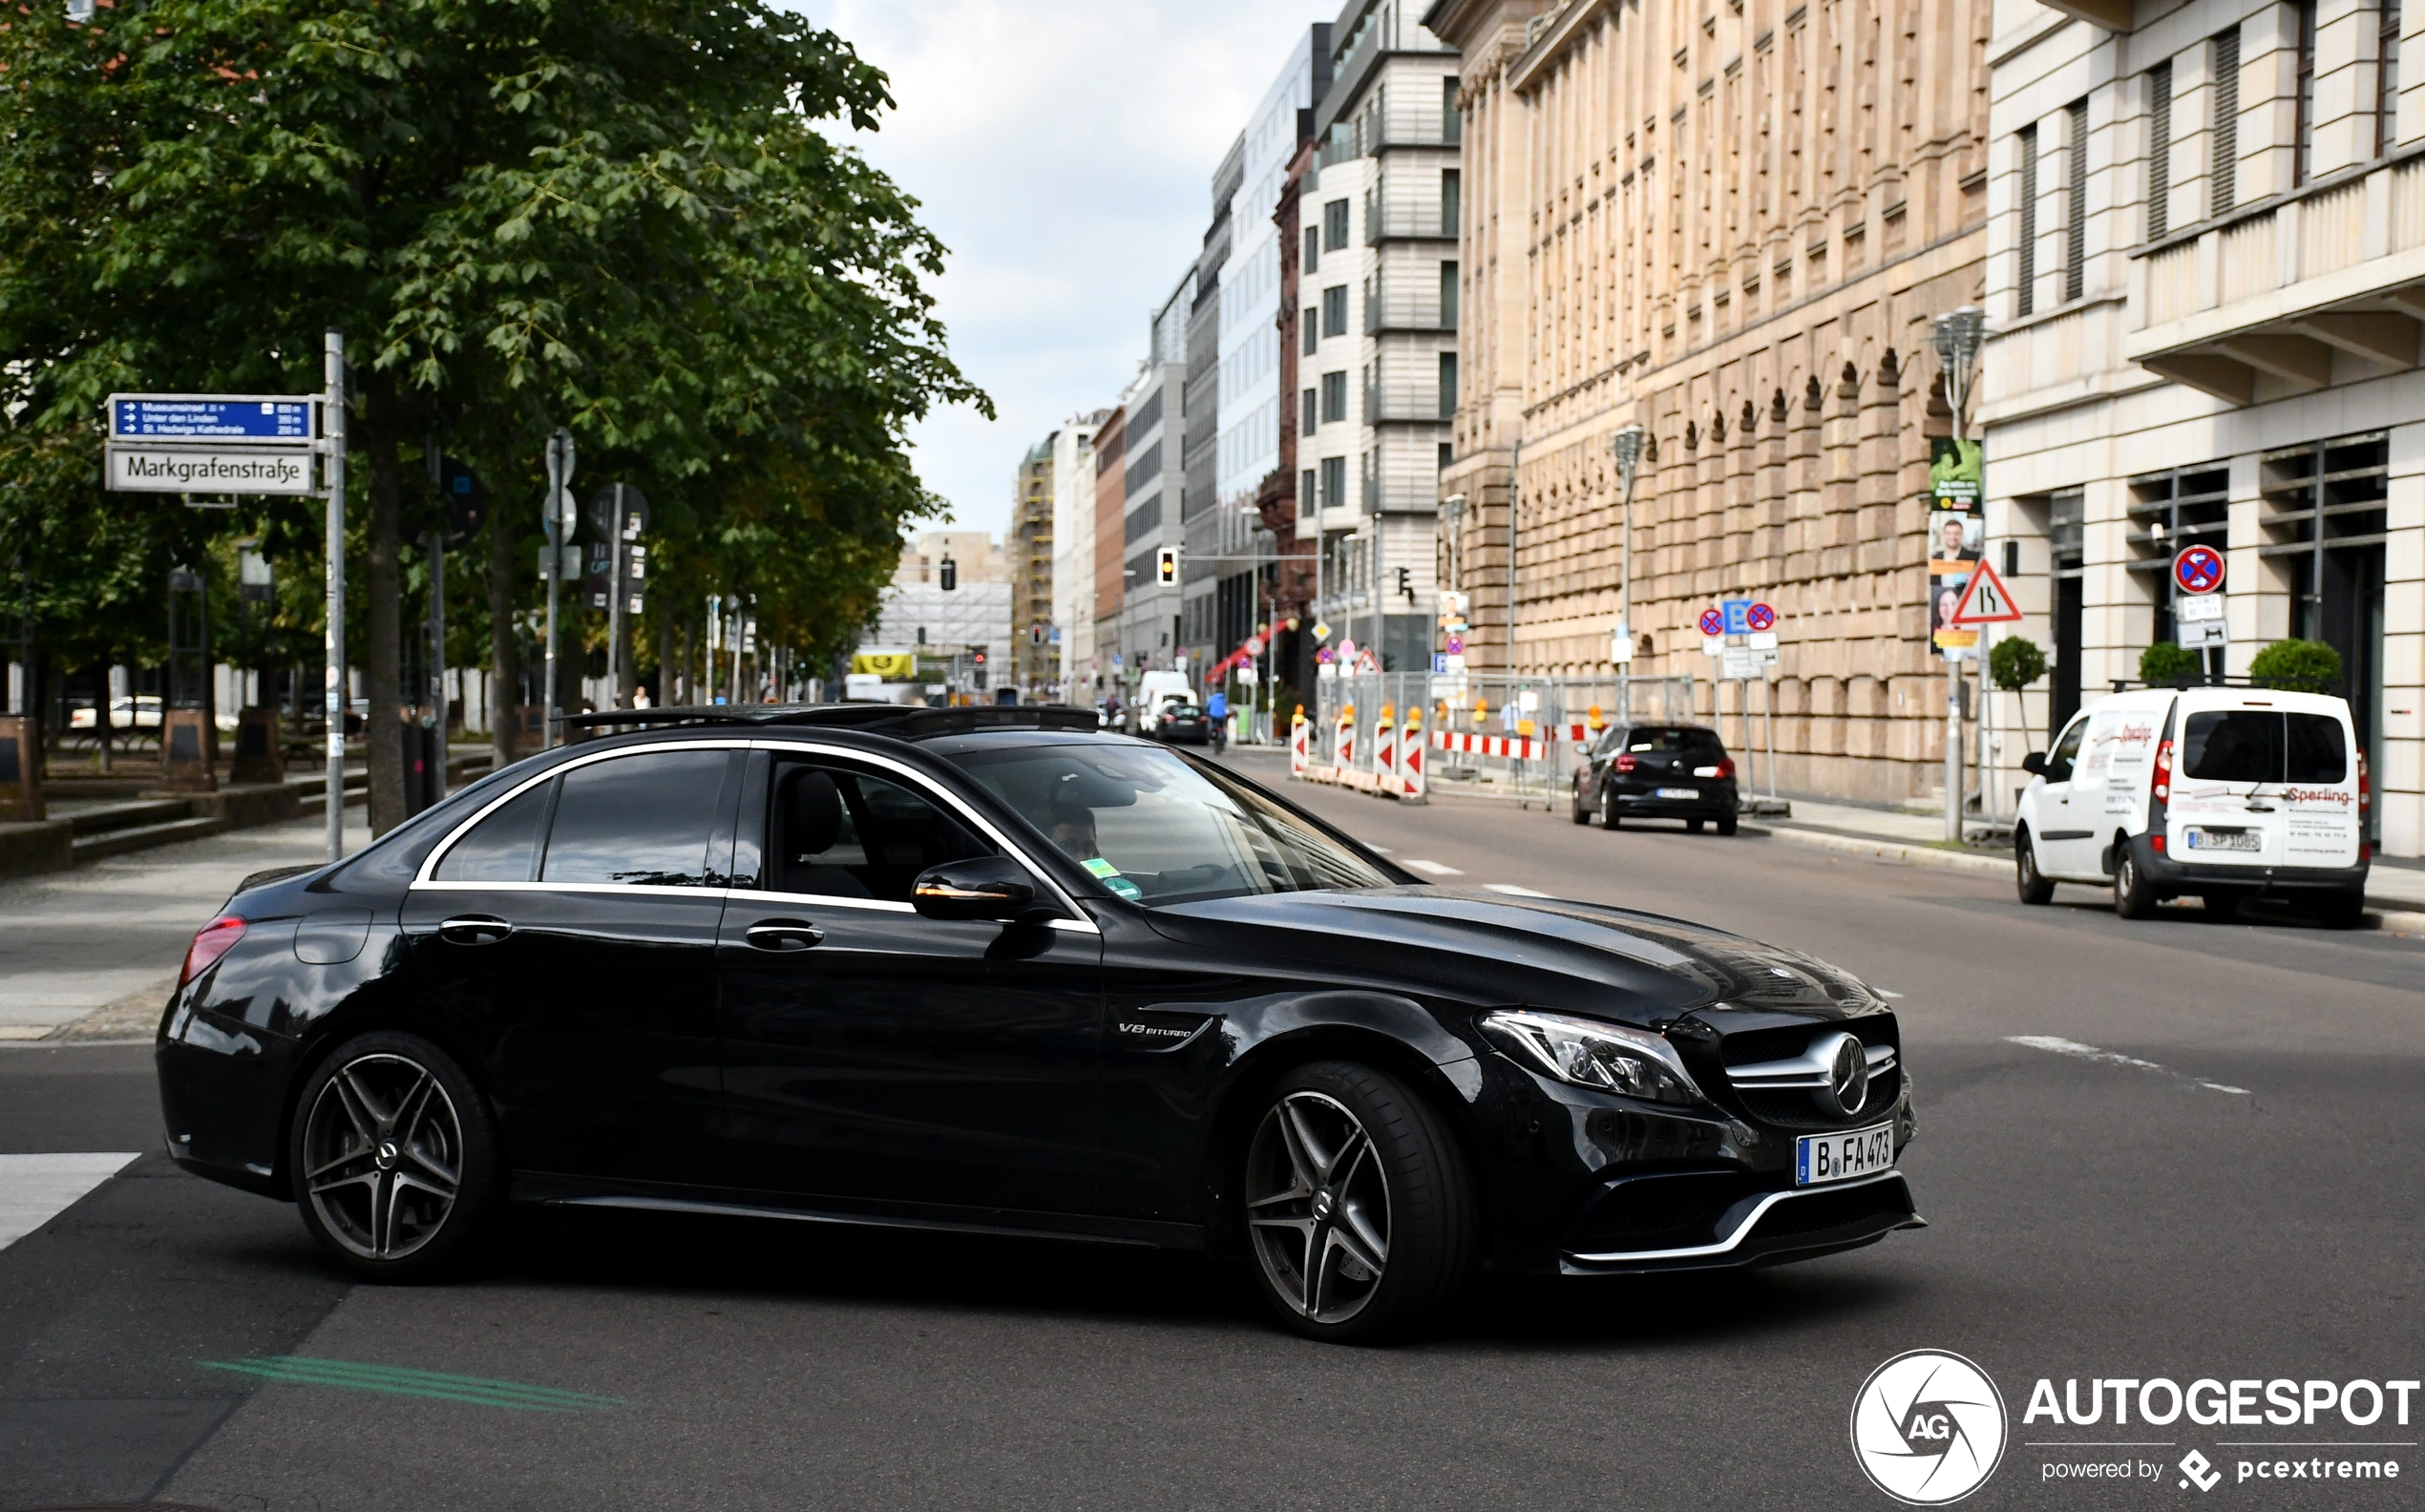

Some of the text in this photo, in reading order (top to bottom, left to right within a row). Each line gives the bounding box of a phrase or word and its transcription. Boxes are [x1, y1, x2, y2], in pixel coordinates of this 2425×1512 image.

[141, 402, 205, 412] Museumsinsel
[142, 413, 167, 423] Unter
[168, 413, 187, 423] den
[188, 414, 219, 424] Linden
[142, 424, 155, 433] St.
[128, 456, 300, 483] Markgrafenstraße
[2288, 788, 2349, 806] Sperling
[1119, 1022, 1191, 1038] V8 BITURBO
[1818, 1129, 1889, 1177] B FA 473
